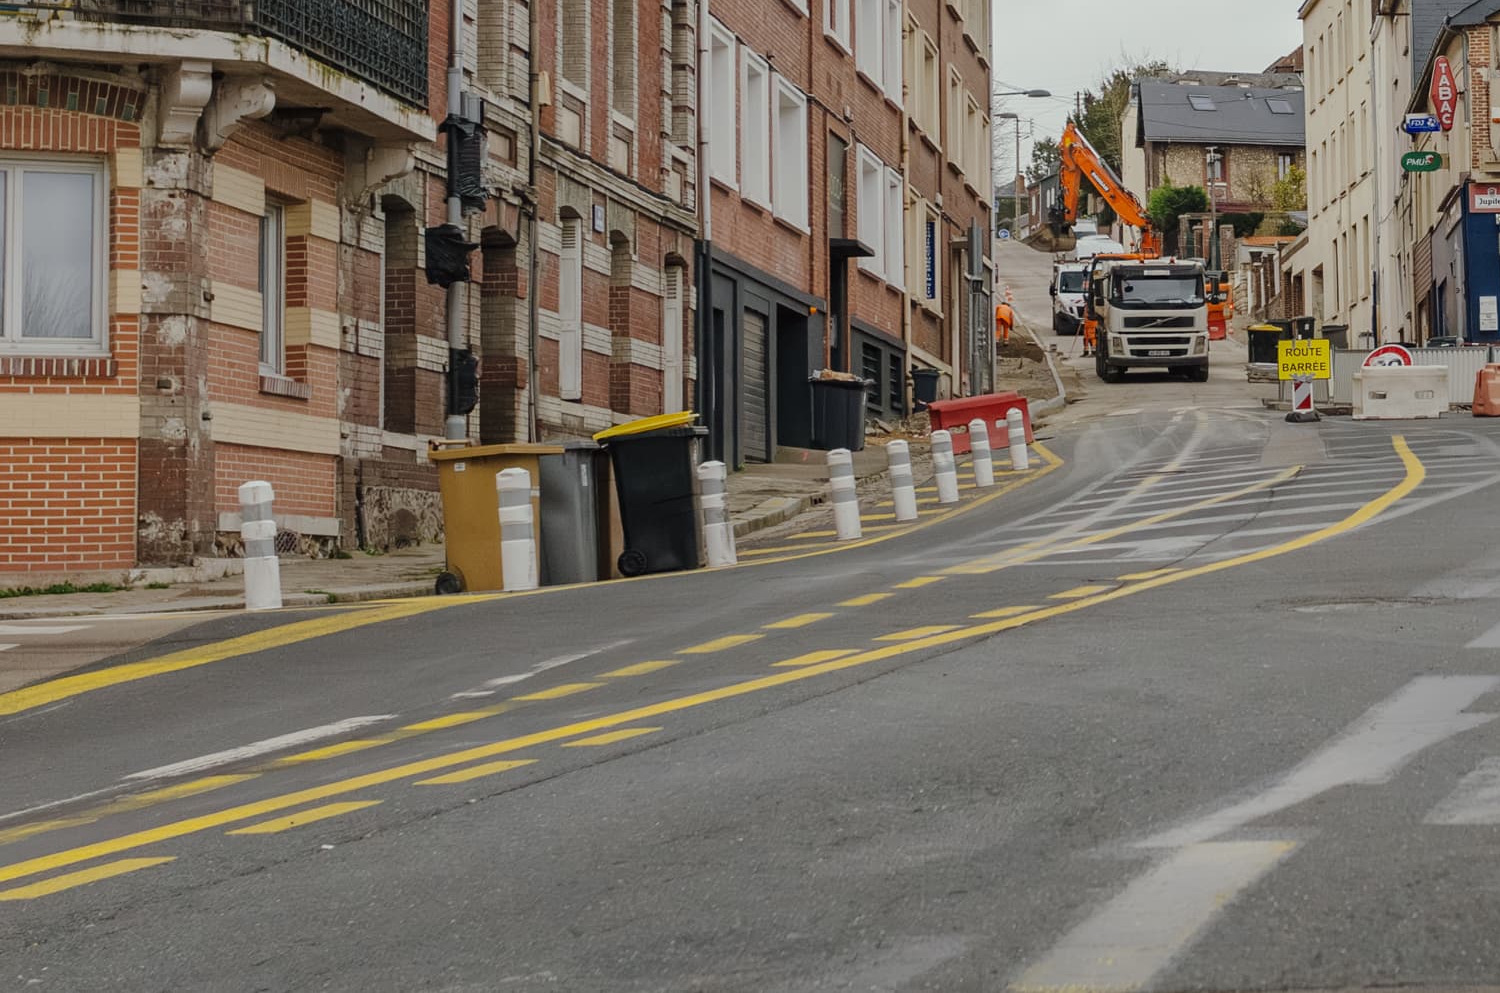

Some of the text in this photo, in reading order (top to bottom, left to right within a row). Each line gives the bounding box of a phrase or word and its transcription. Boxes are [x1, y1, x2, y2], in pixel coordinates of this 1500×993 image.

[1438, 63, 1453, 125] TABAC
[1410, 119, 1425, 127] FDJ
[1406, 158, 1425, 166] PMU
[1285, 347, 1322, 357] ROUTE
[1282, 361, 1326, 372] BARRÉE
